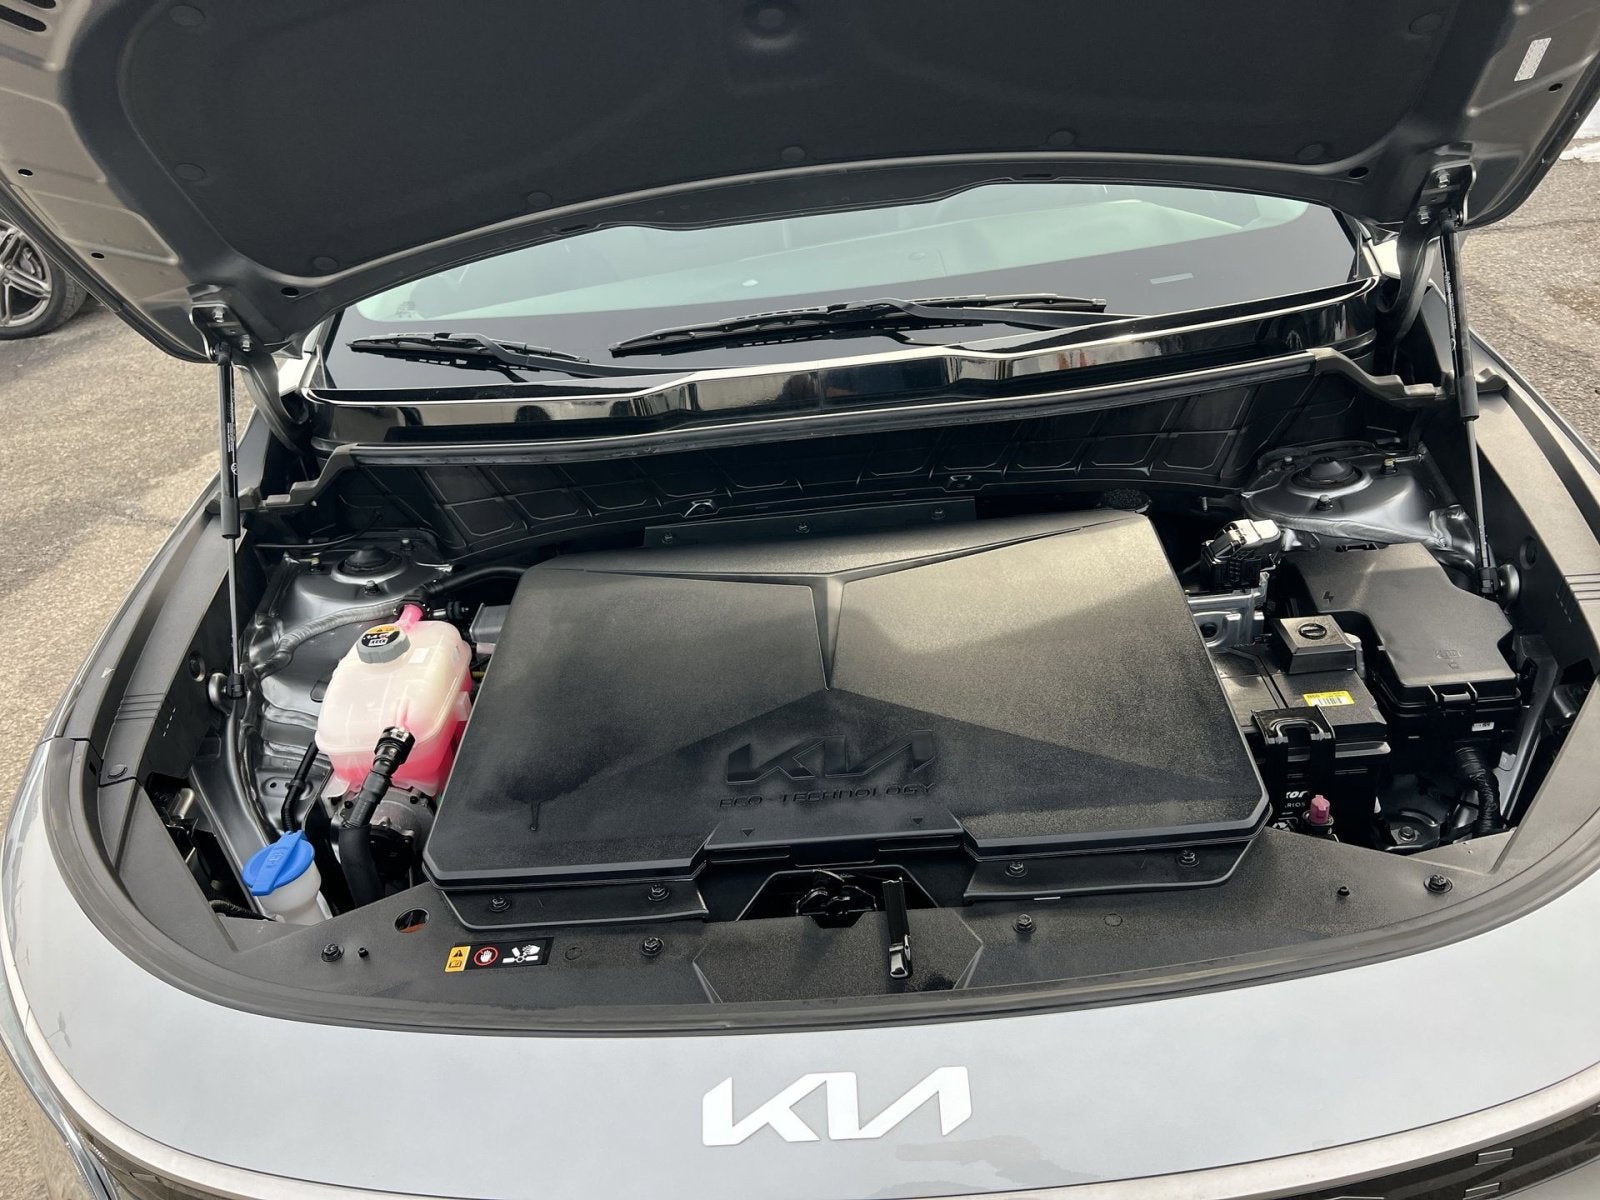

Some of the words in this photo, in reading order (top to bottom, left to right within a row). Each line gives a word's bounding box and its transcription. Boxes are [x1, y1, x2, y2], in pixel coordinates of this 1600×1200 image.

[727, 729, 936, 785] KIA
[719, 794, 763, 808] ECO
[781, 783, 936, 804] TECHNOLOGY
[702, 1066, 972, 1146] KIA
